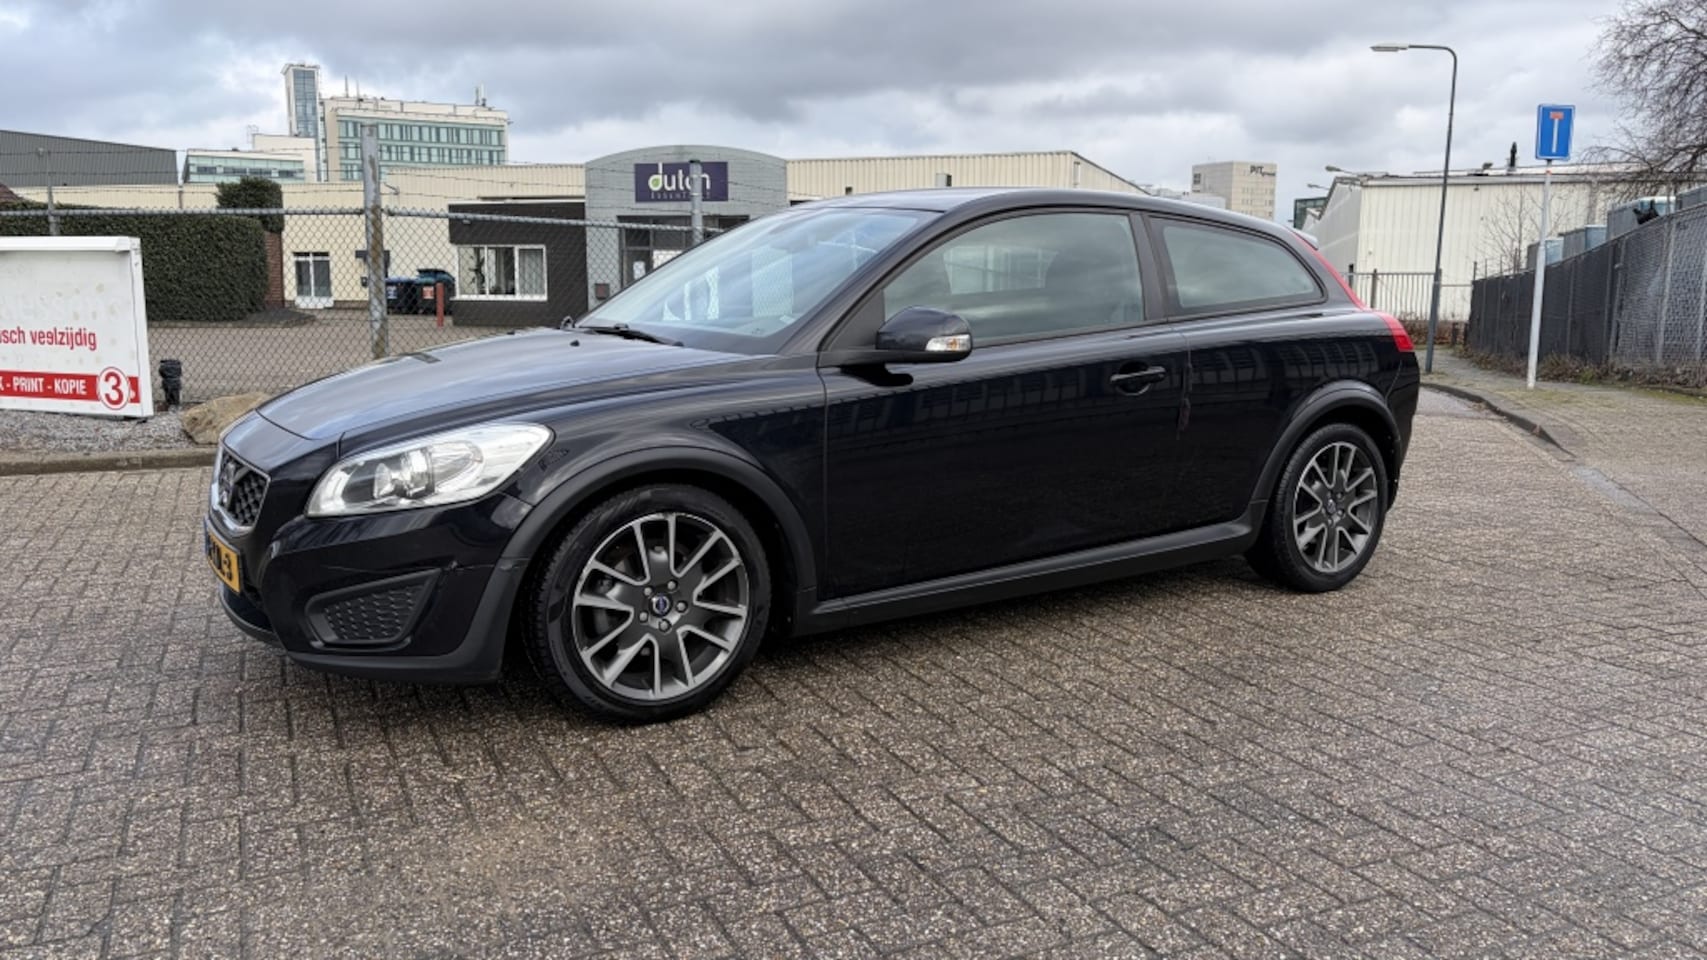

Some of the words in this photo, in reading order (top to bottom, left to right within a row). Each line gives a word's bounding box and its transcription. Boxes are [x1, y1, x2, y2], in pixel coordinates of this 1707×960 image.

[0, 326, 26, 345] sch
[30, 327, 97, 351] veelzijdig
[12, 376, 45, 392] PRINT
[54, 378, 87, 395] KOPIE
[104, 371, 124, 405] 3
